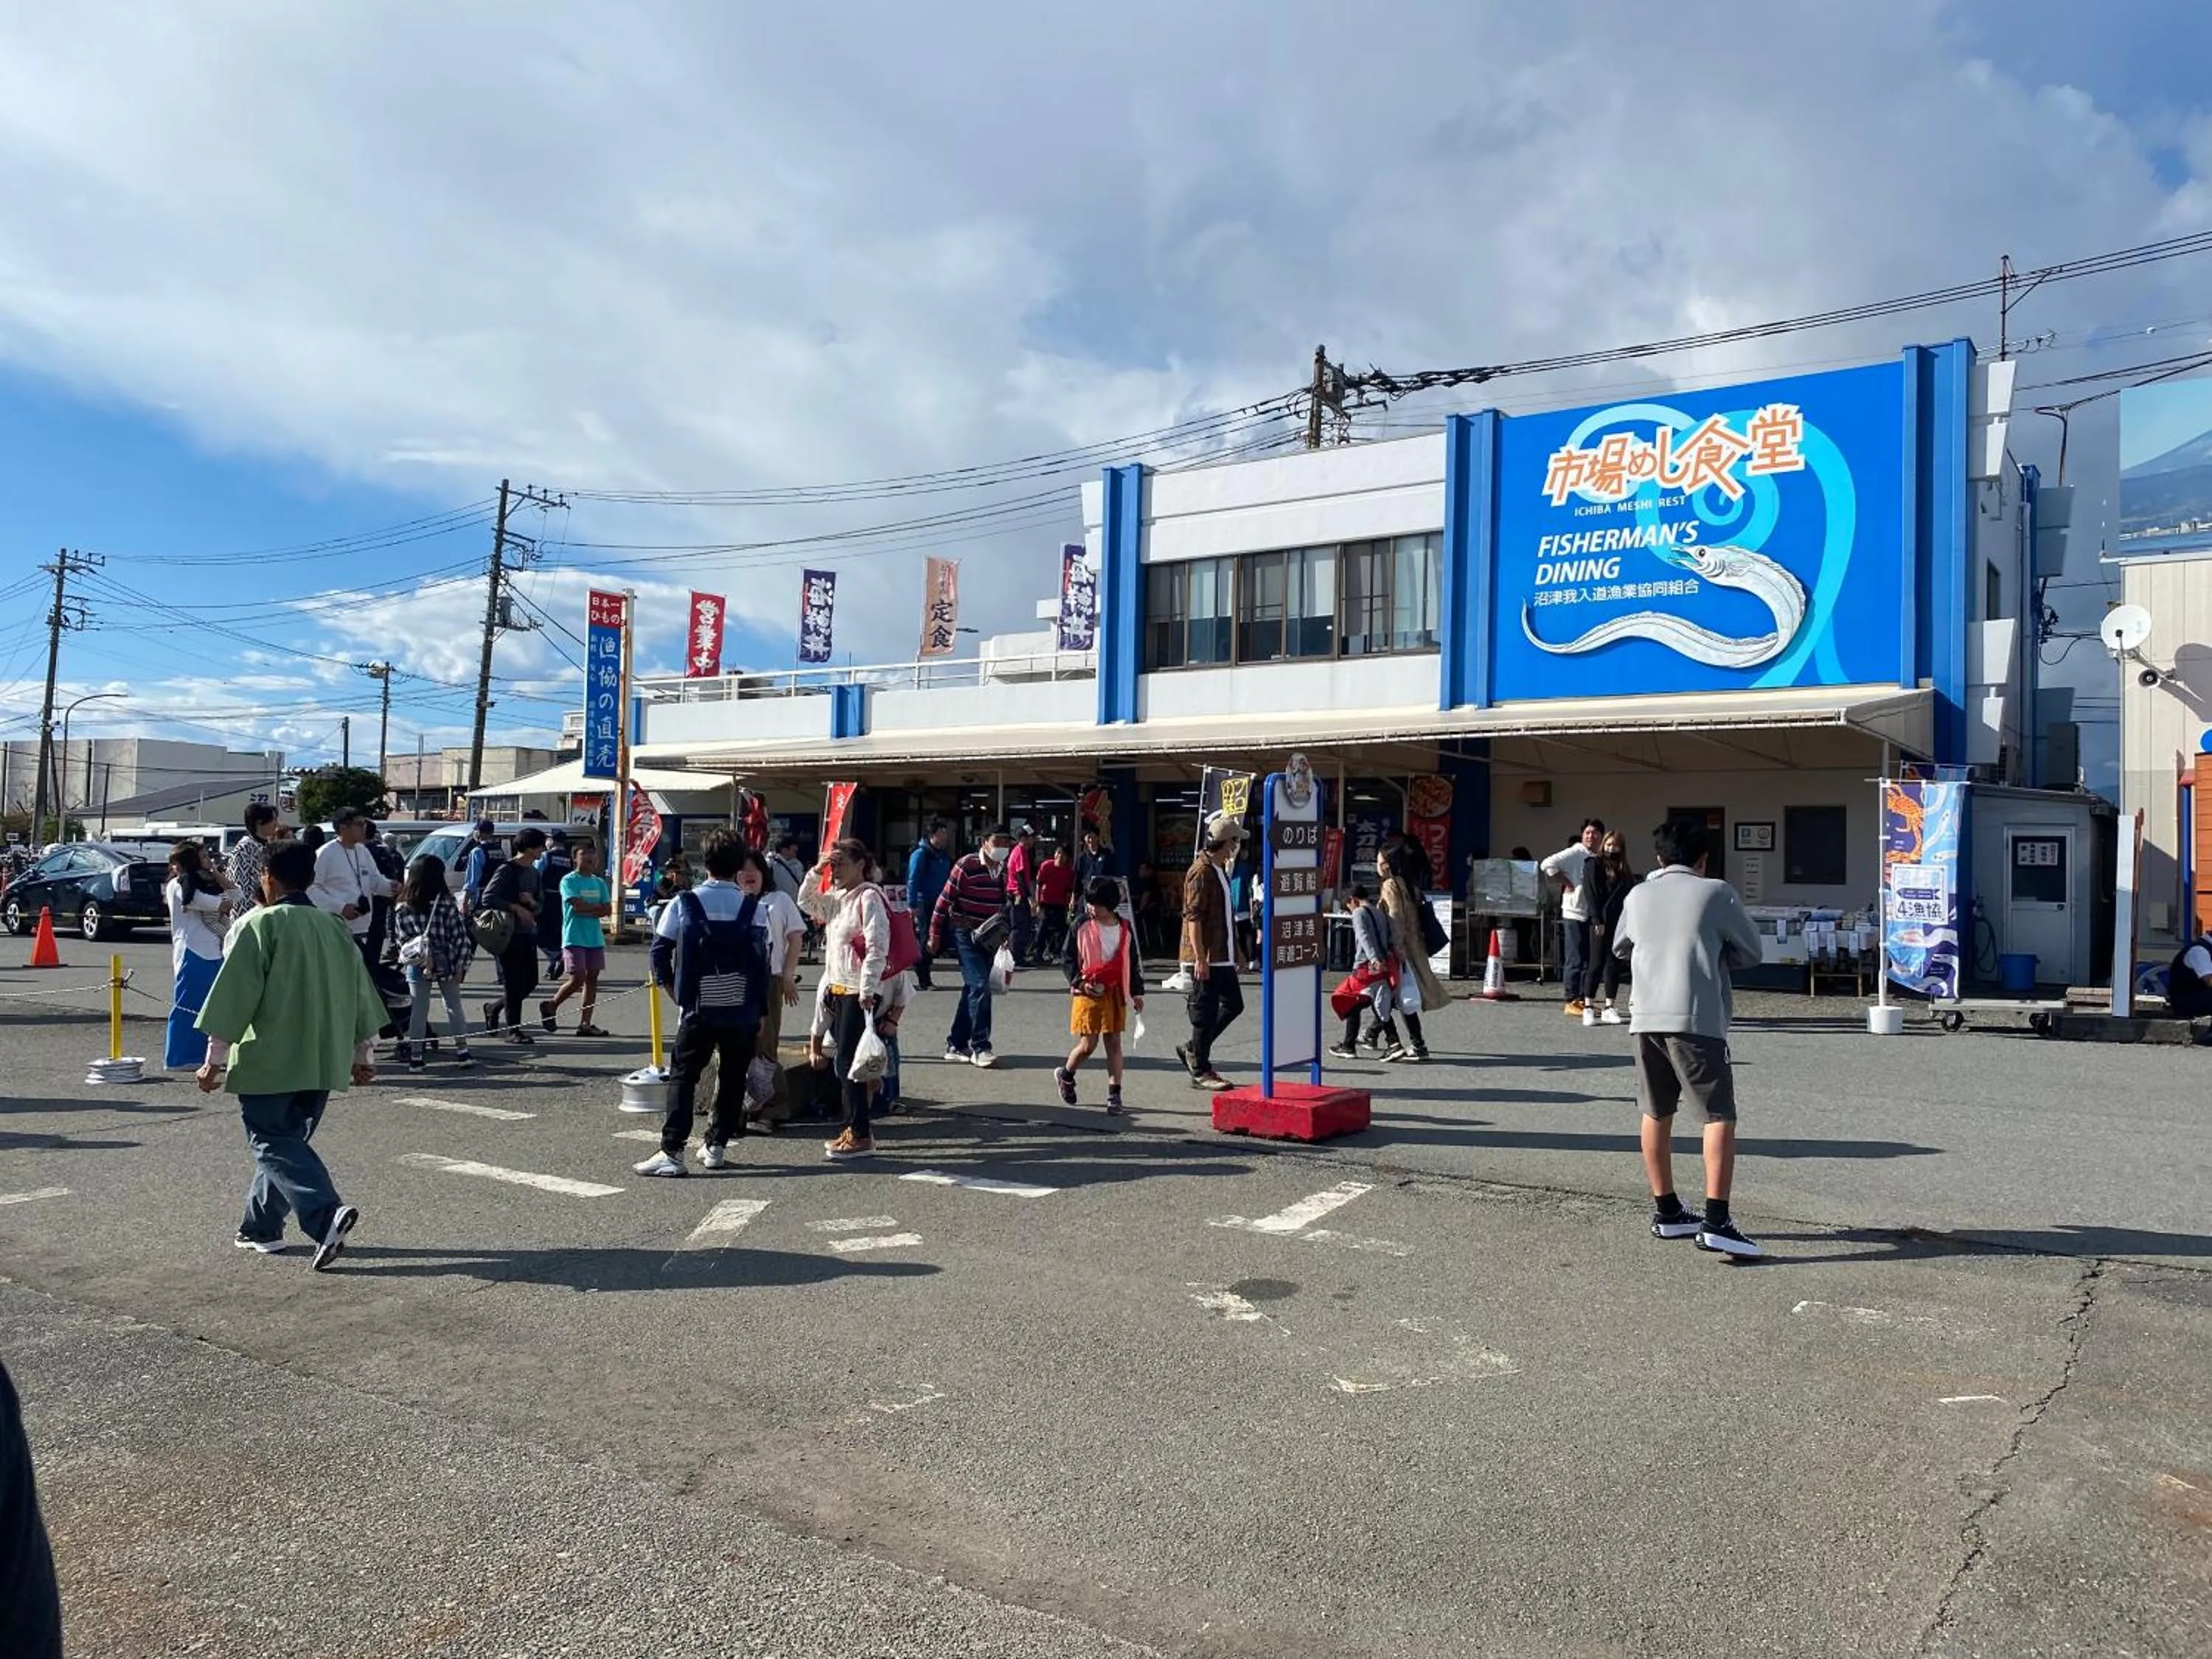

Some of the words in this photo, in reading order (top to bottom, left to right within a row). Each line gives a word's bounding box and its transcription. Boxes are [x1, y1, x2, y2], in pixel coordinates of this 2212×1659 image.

[1542, 403, 1805, 507] 市場めし食堂
[1574, 506, 1611, 517] ICHIBA
[1617, 500, 1652, 512] MESHI
[1659, 495, 1686, 507] REST
[1537, 521, 1700, 558] FISHERMAN'S
[1535, 557, 1621, 585] DINING
[592, 597, 620, 608] 日本一
[1534, 578, 1700, 607] 沼津我入道漁業協同組合
[591, 611, 620, 625] ひもの
[929, 599, 954, 648] 定食
[597, 636, 618, 768] 漁協の直売
[1282, 827, 1318, 845] のりば
[1279, 873, 1316, 891] 遊覧船
